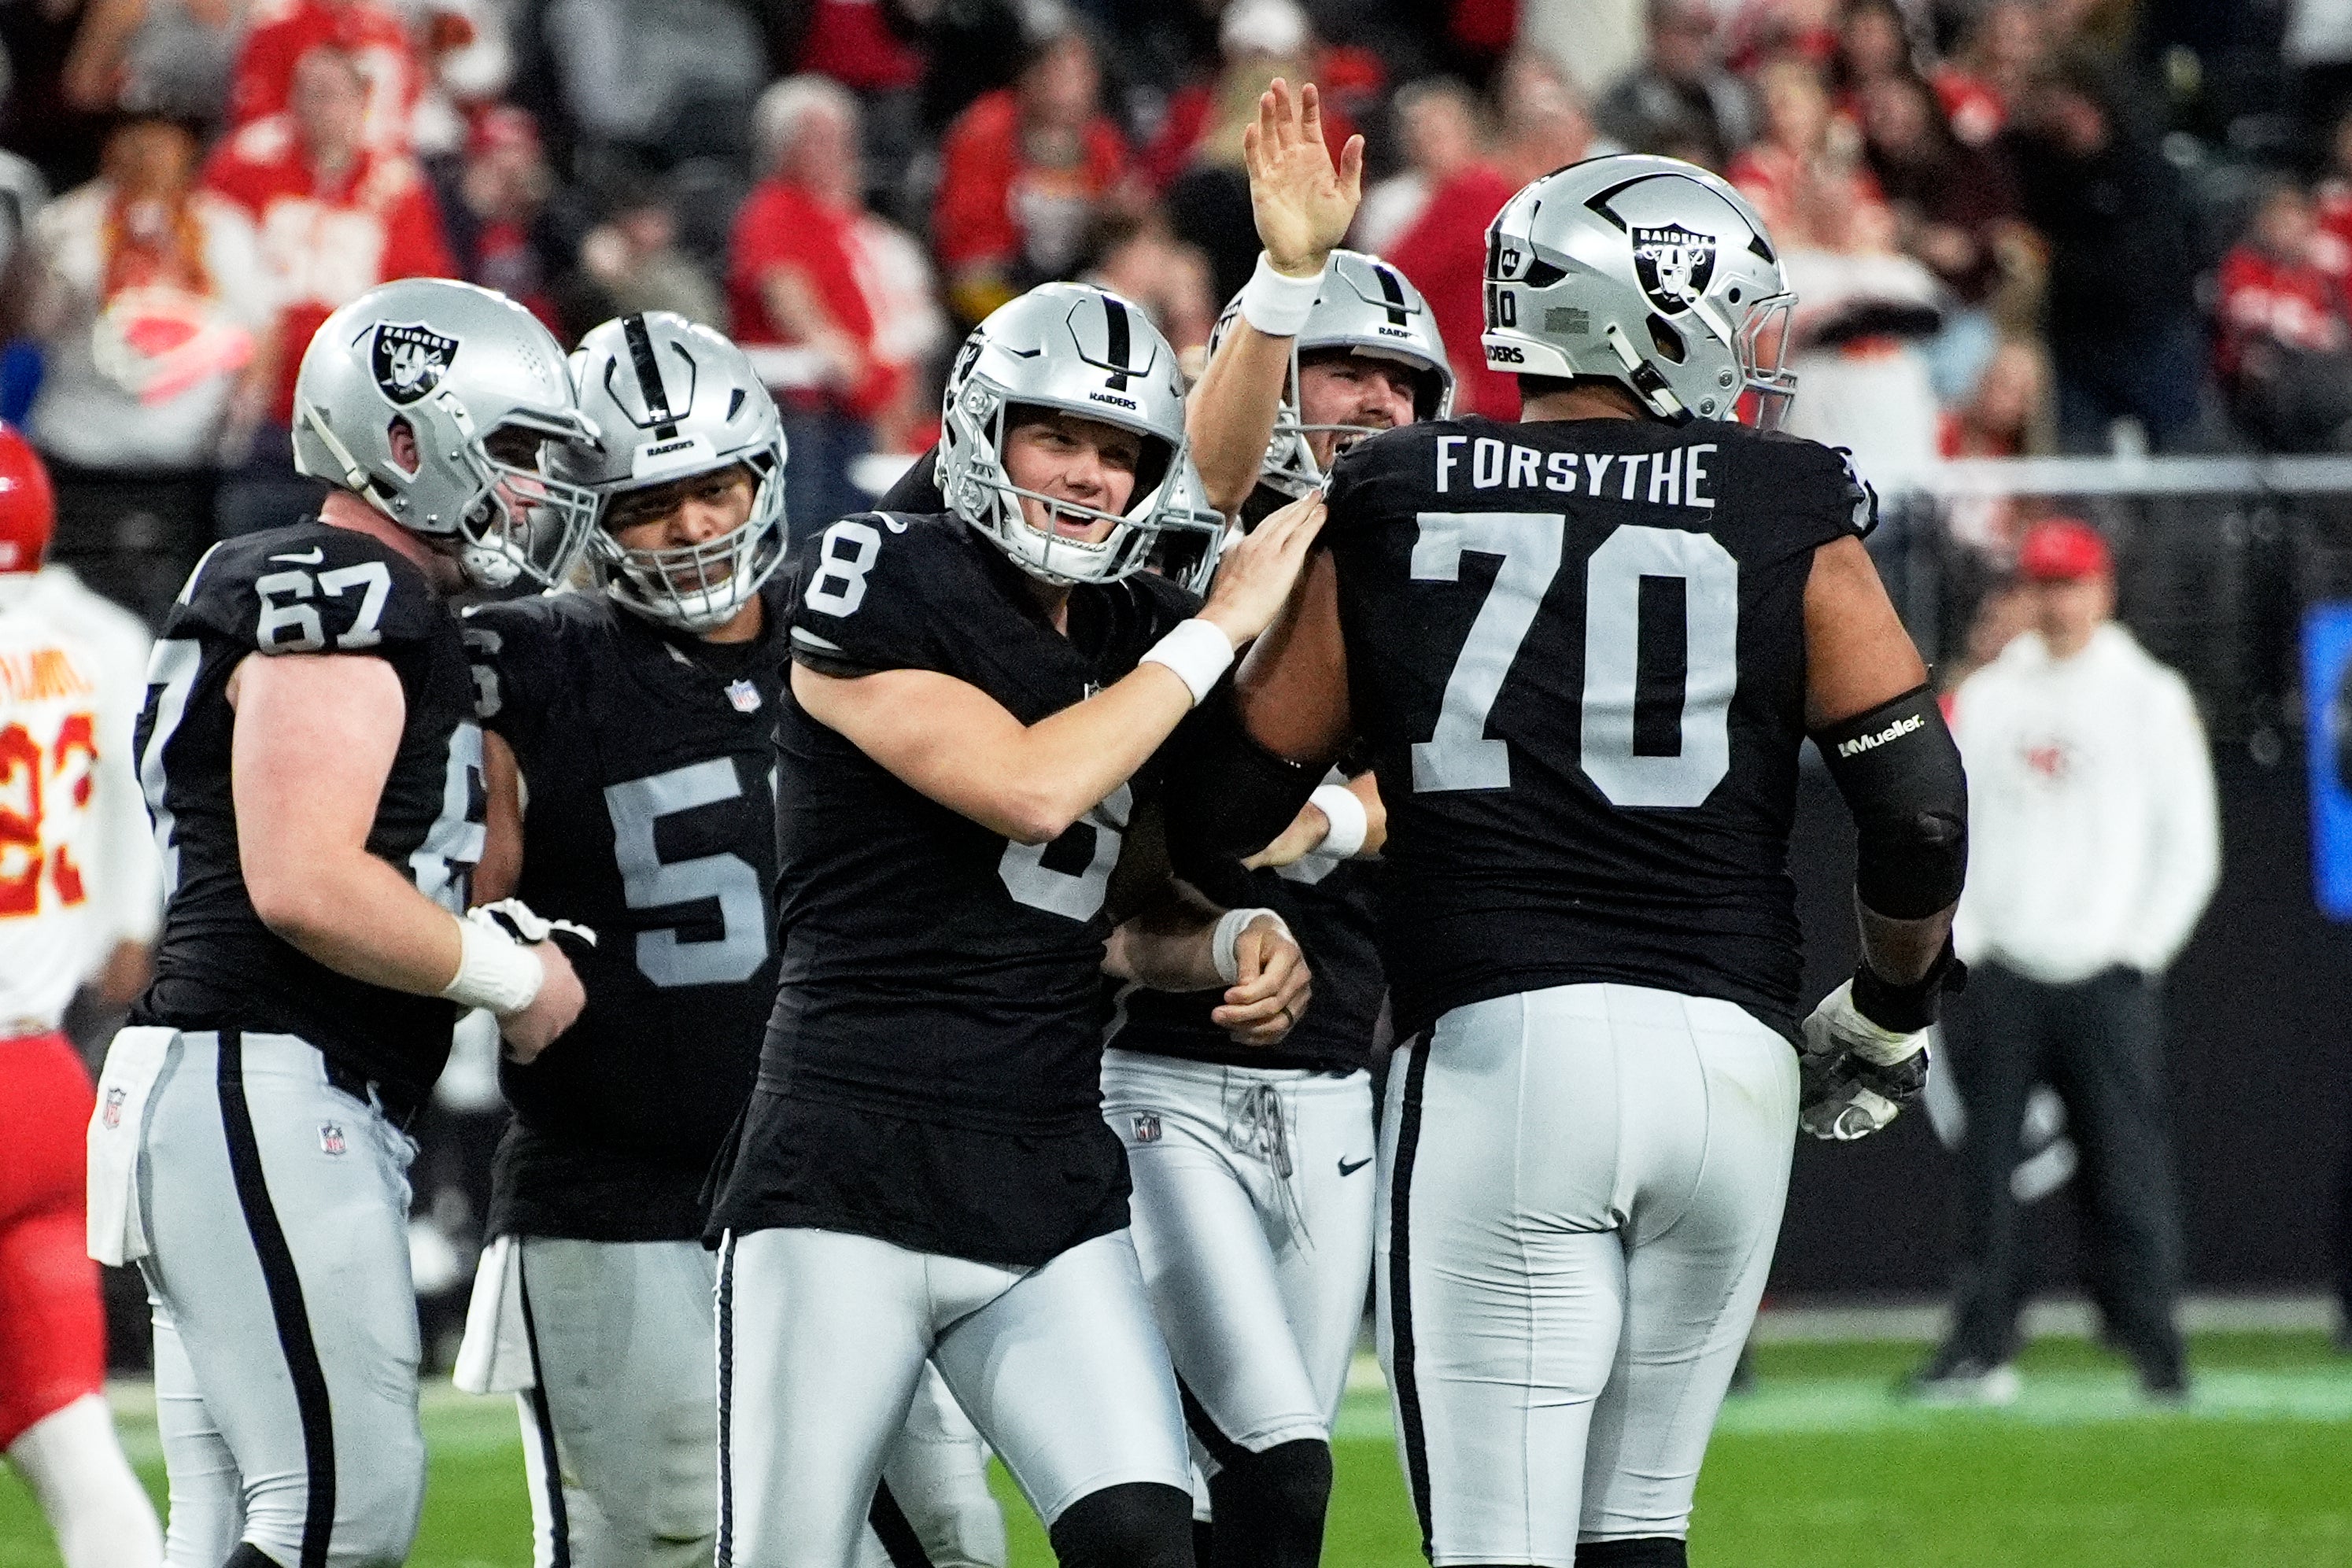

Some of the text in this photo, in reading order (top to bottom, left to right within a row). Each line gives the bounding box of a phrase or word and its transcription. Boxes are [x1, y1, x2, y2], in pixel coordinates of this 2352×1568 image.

[1501, 253, 1517, 267] AL
[1640, 229, 1709, 245] RAIDERS
[382, 327, 451, 350] RAIDERS
[1089, 389, 1136, 411] RAIDERS
[1436, 435, 1719, 508] FORSYTHE
[804, 519, 882, 618] 8
[254, 560, 392, 656] 67
[1409, 511, 1739, 808] 70
